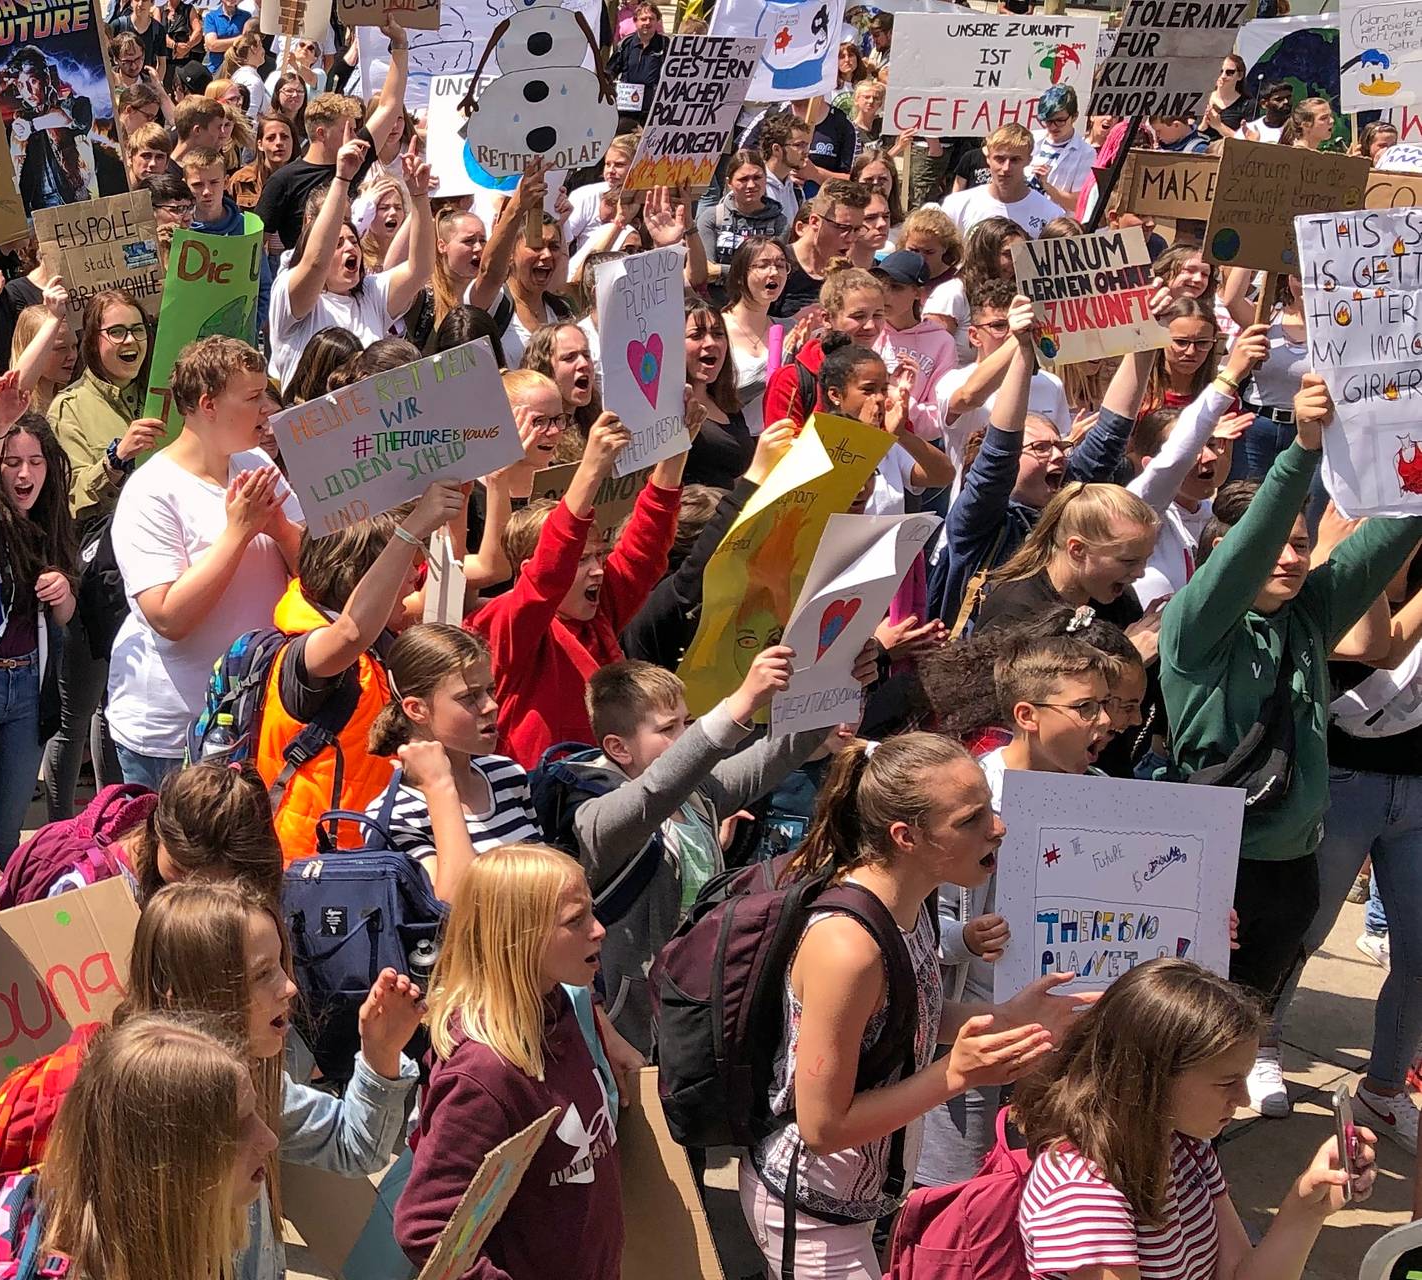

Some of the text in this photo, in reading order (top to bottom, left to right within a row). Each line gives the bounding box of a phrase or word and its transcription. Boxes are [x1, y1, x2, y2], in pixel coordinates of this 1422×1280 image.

[1126, 0, 1248, 30] TOLERANZ
[946, 23, 1075, 39] UNSERE ZUKUNFT
[1111, 30, 1161, 58] FÜR
[669, 35, 736, 58] LEUTE
[979, 48, 1012, 65] IST
[665, 55, 755, 80] GESTERN
[972, 69, 1002, 88] IN
[1098, 61, 1170, 88] KLIMA
[657, 80, 731, 103] MACHEN
[1087, 91, 1204, 117] IGNORANZ
[648, 102, 725, 127] POLITIK
[555, 141, 602, 169] OLAF
[653, 130, 730, 156] MORGEN
[54, 210, 137, 250] EISPOLE
[1309, 213, 1381, 249] THIS
[178, 239, 234, 285] Die
[1026, 232, 1127, 277] WARUM
[1021, 263, 1165, 303] LERNEN OHNE
[1313, 258, 1339, 293] IS
[624, 276, 671, 320] PLANET
[1309, 294, 1418, 328] HOTTER
[636, 316, 649, 344] B
[1312, 339, 1347, 368] MY
[289, 350, 478, 445] HEUTE RETTEN
[379, 396, 424, 429] WIR
[1036, 907, 1115, 945] THERE
[1040, 950, 1139, 979] PLANET
